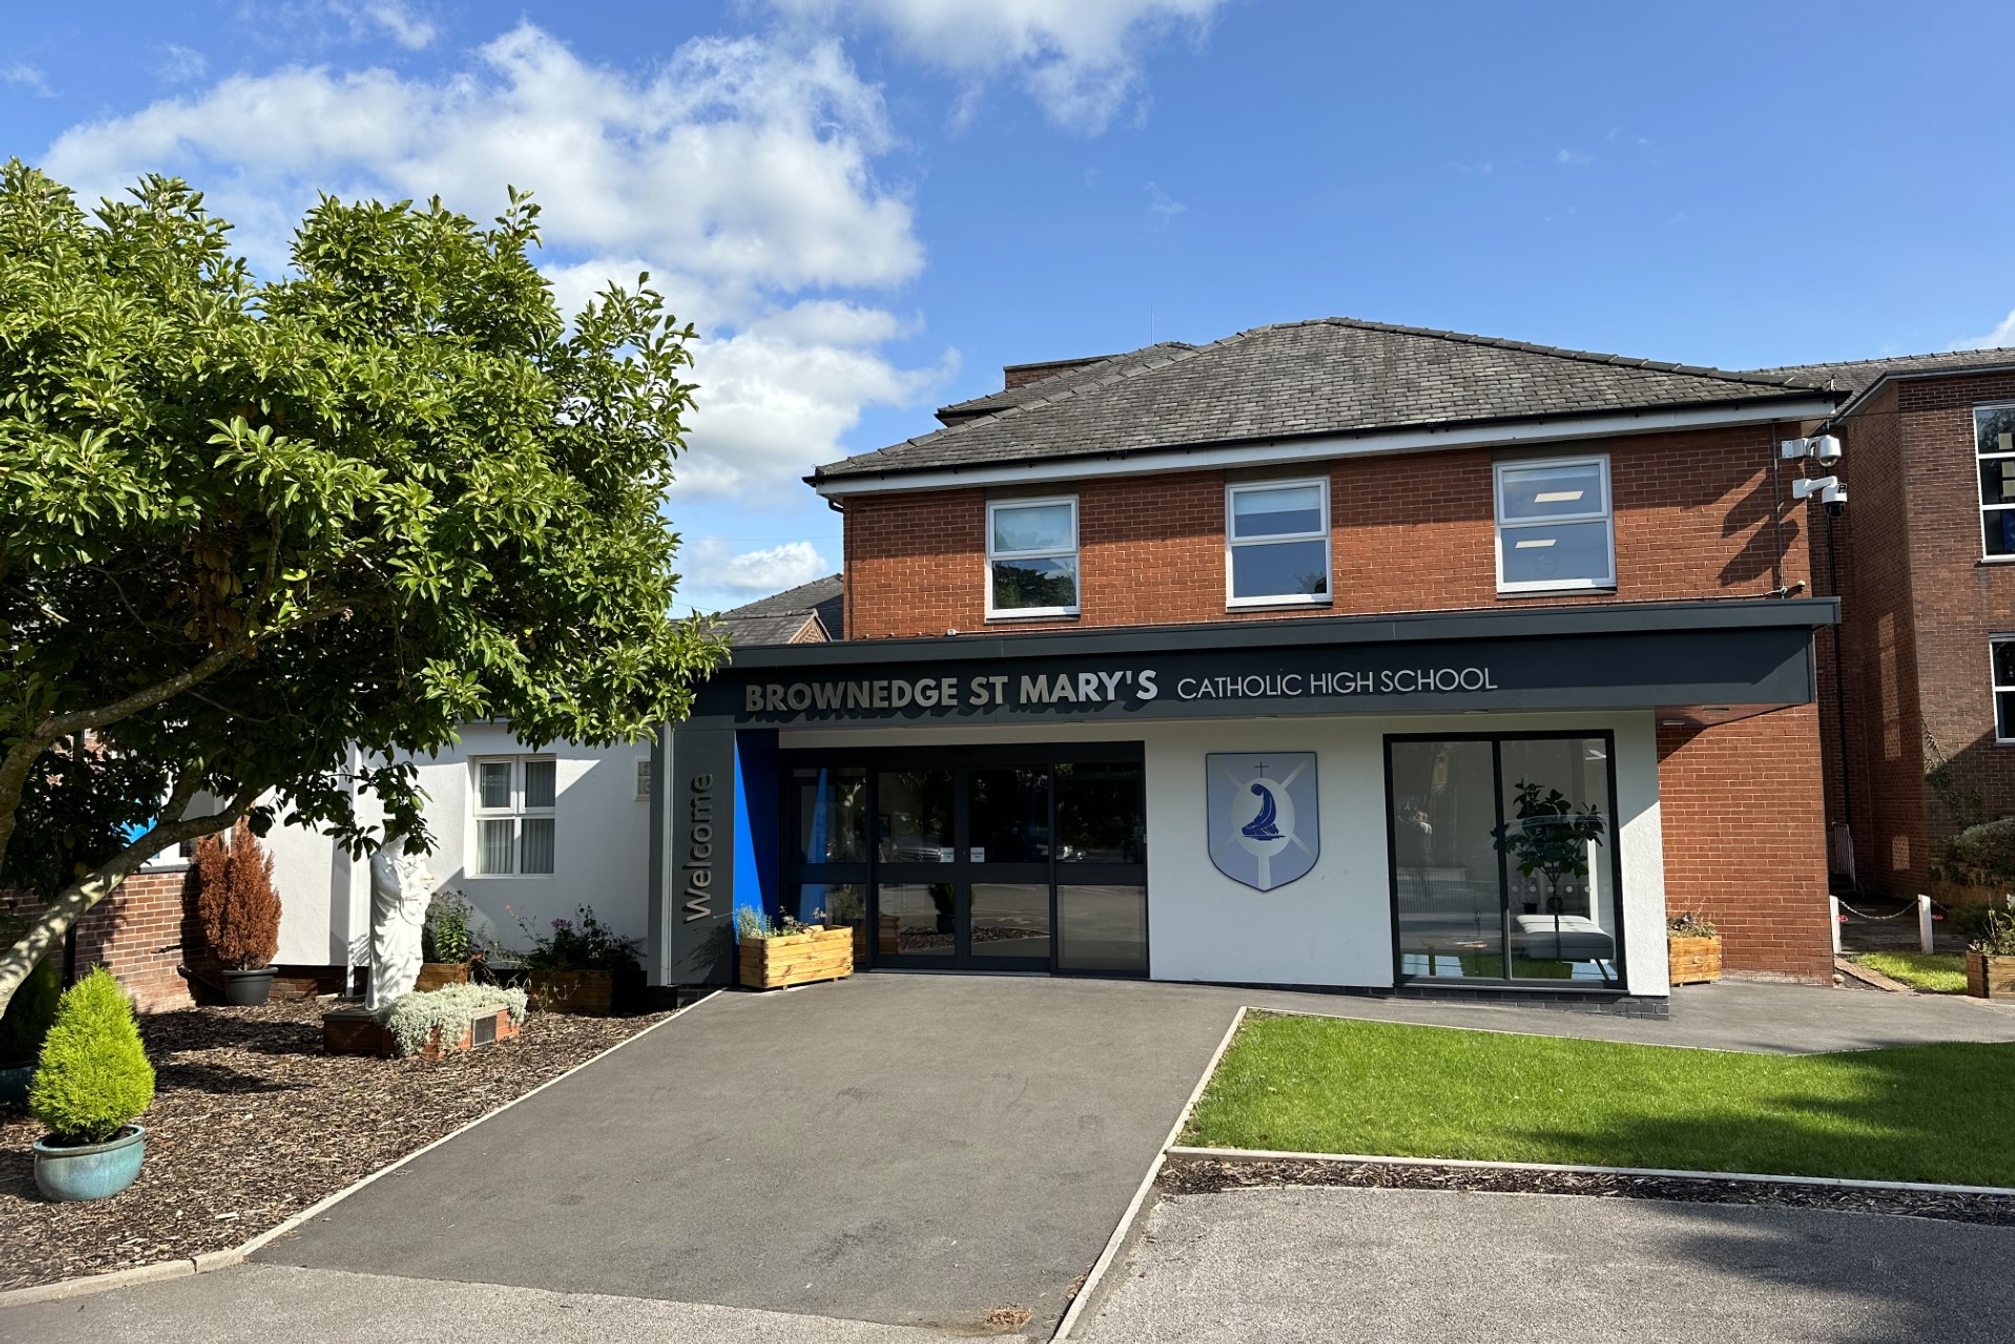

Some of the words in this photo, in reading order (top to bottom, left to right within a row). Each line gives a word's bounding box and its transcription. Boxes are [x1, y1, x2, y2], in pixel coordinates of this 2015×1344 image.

[745, 677, 958, 712] BROWNEDGE
[969, 676, 1008, 706] ST
[1019, 669, 1158, 703] MARY'S
[1177, 674, 1302, 699] CATHOLIC
[1310, 671, 1374, 694] HIGH
[1380, 667, 1498, 692] SCHOOL
[685, 773, 713, 922] Welcome
